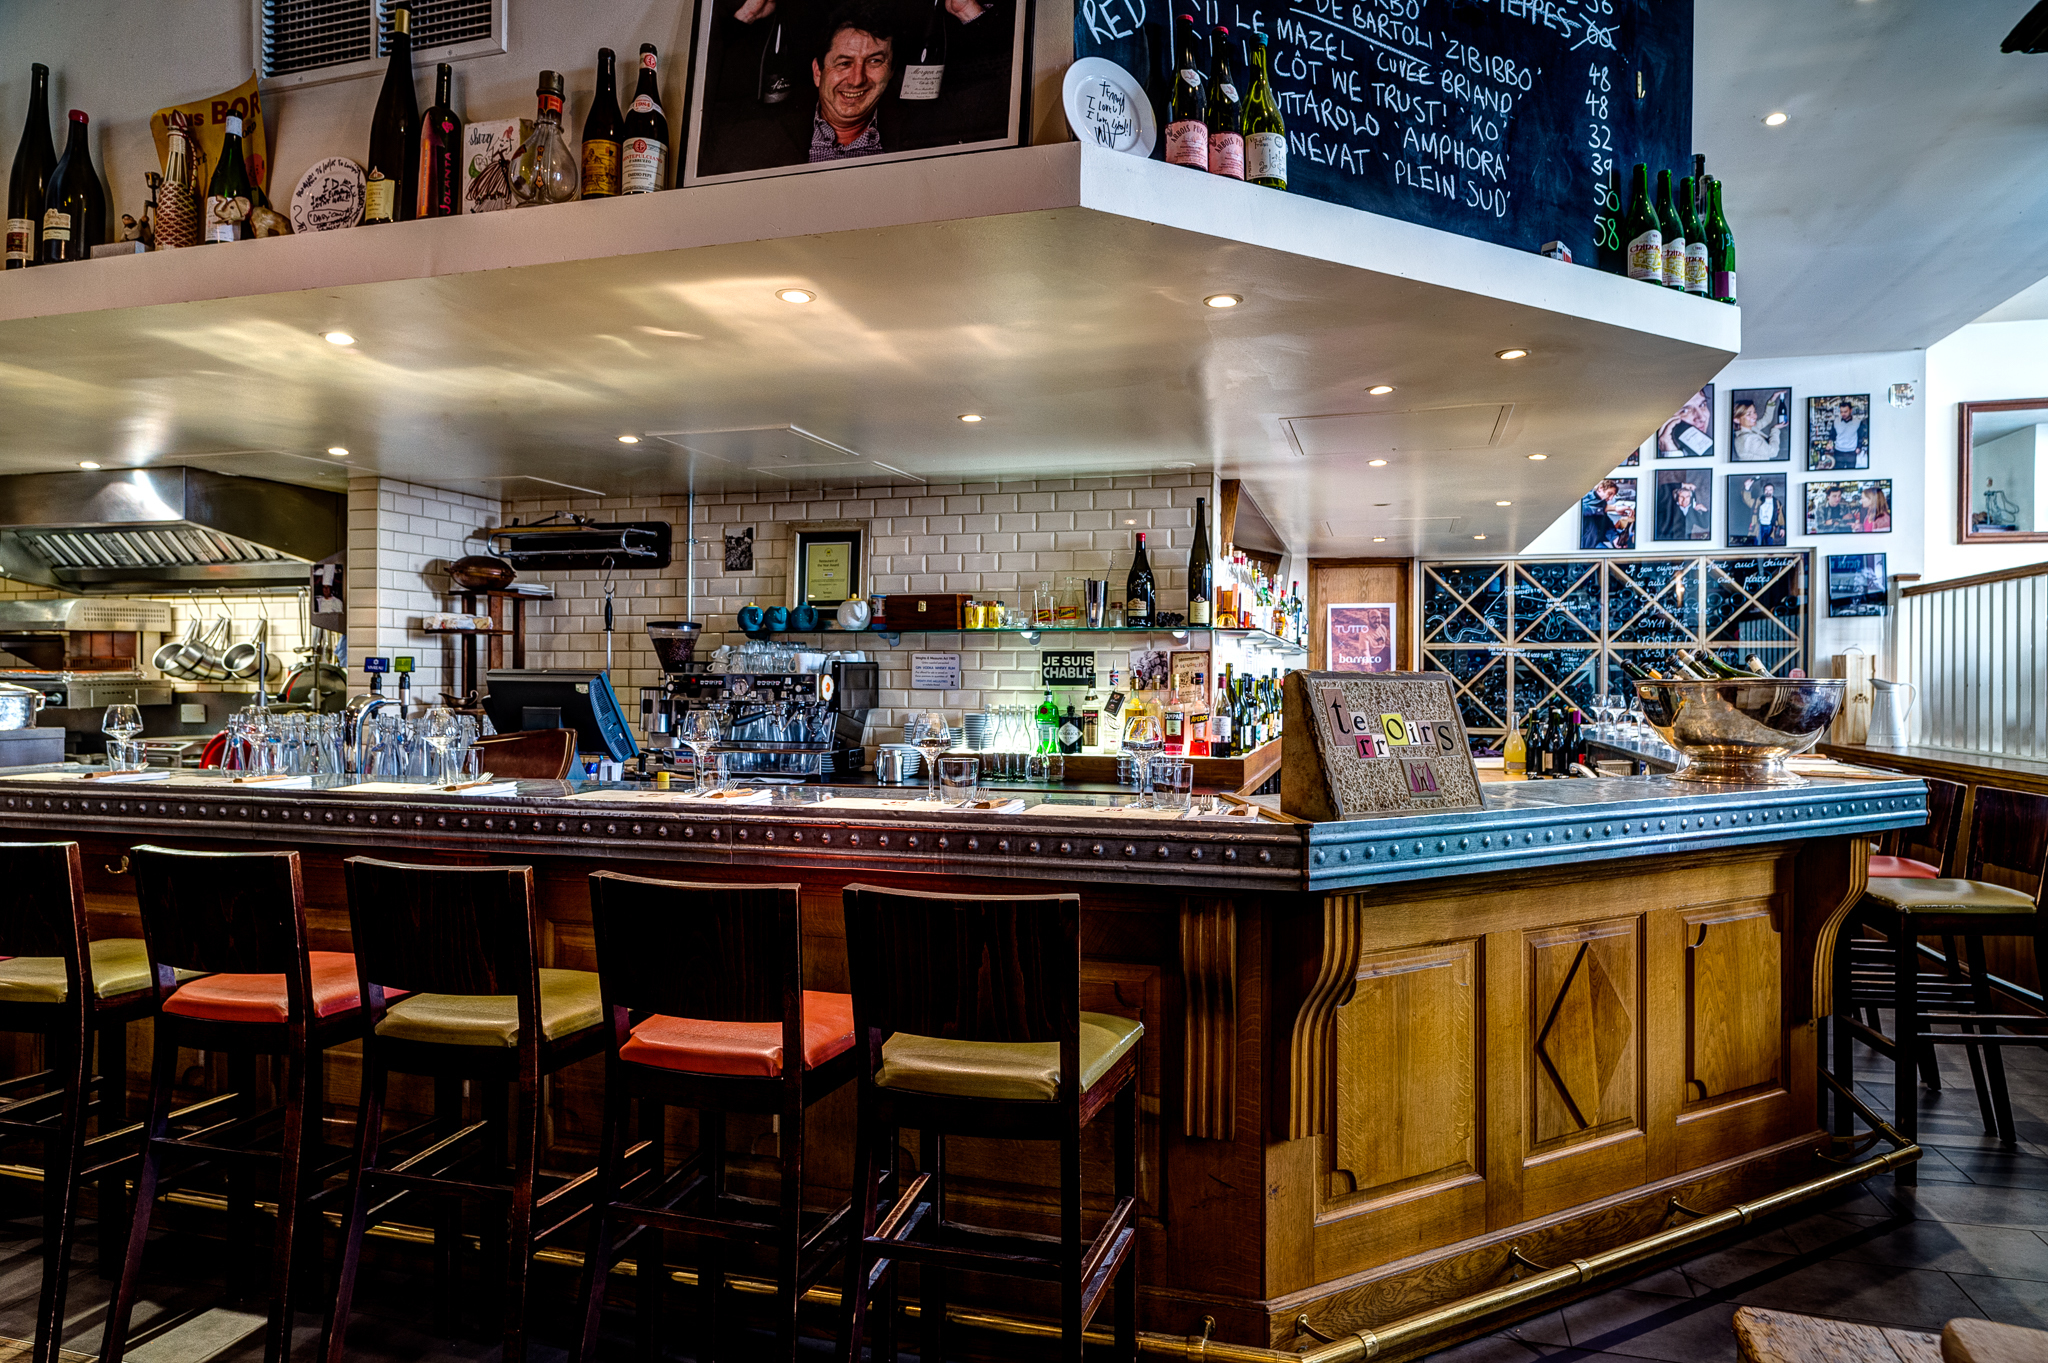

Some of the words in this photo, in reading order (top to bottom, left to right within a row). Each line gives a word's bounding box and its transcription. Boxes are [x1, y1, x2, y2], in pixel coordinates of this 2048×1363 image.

[1083, 0, 1147, 45] RED
[1352, 4, 1433, 50] BARTOLI
[1585, 89, 1608, 120] 48
[1589, 62, 1611, 92] 48
[1236, 4, 1265, 34] LE
[1277, 17, 1354, 61] MAZEL
[1588, 124, 1613, 151] 32
[1170, 124, 1191, 144] ARBOIS
[1274, 50, 1323, 85] CÔT
[1331, 67, 1363, 102] WE
[1591, 153, 1613, 190] 39
[440, 152, 452, 215] JOLANTA
[1593, 182, 1620, 212] 50
[1593, 214, 1620, 251] 58
[1335, 625, 1369, 633] TUTTO
[1043, 656, 1060, 667] JE
[1062, 656, 1094, 667] SUIS
[1043, 667, 1093, 679] CHABLIS
[1338, 653, 1382, 664] barraco
